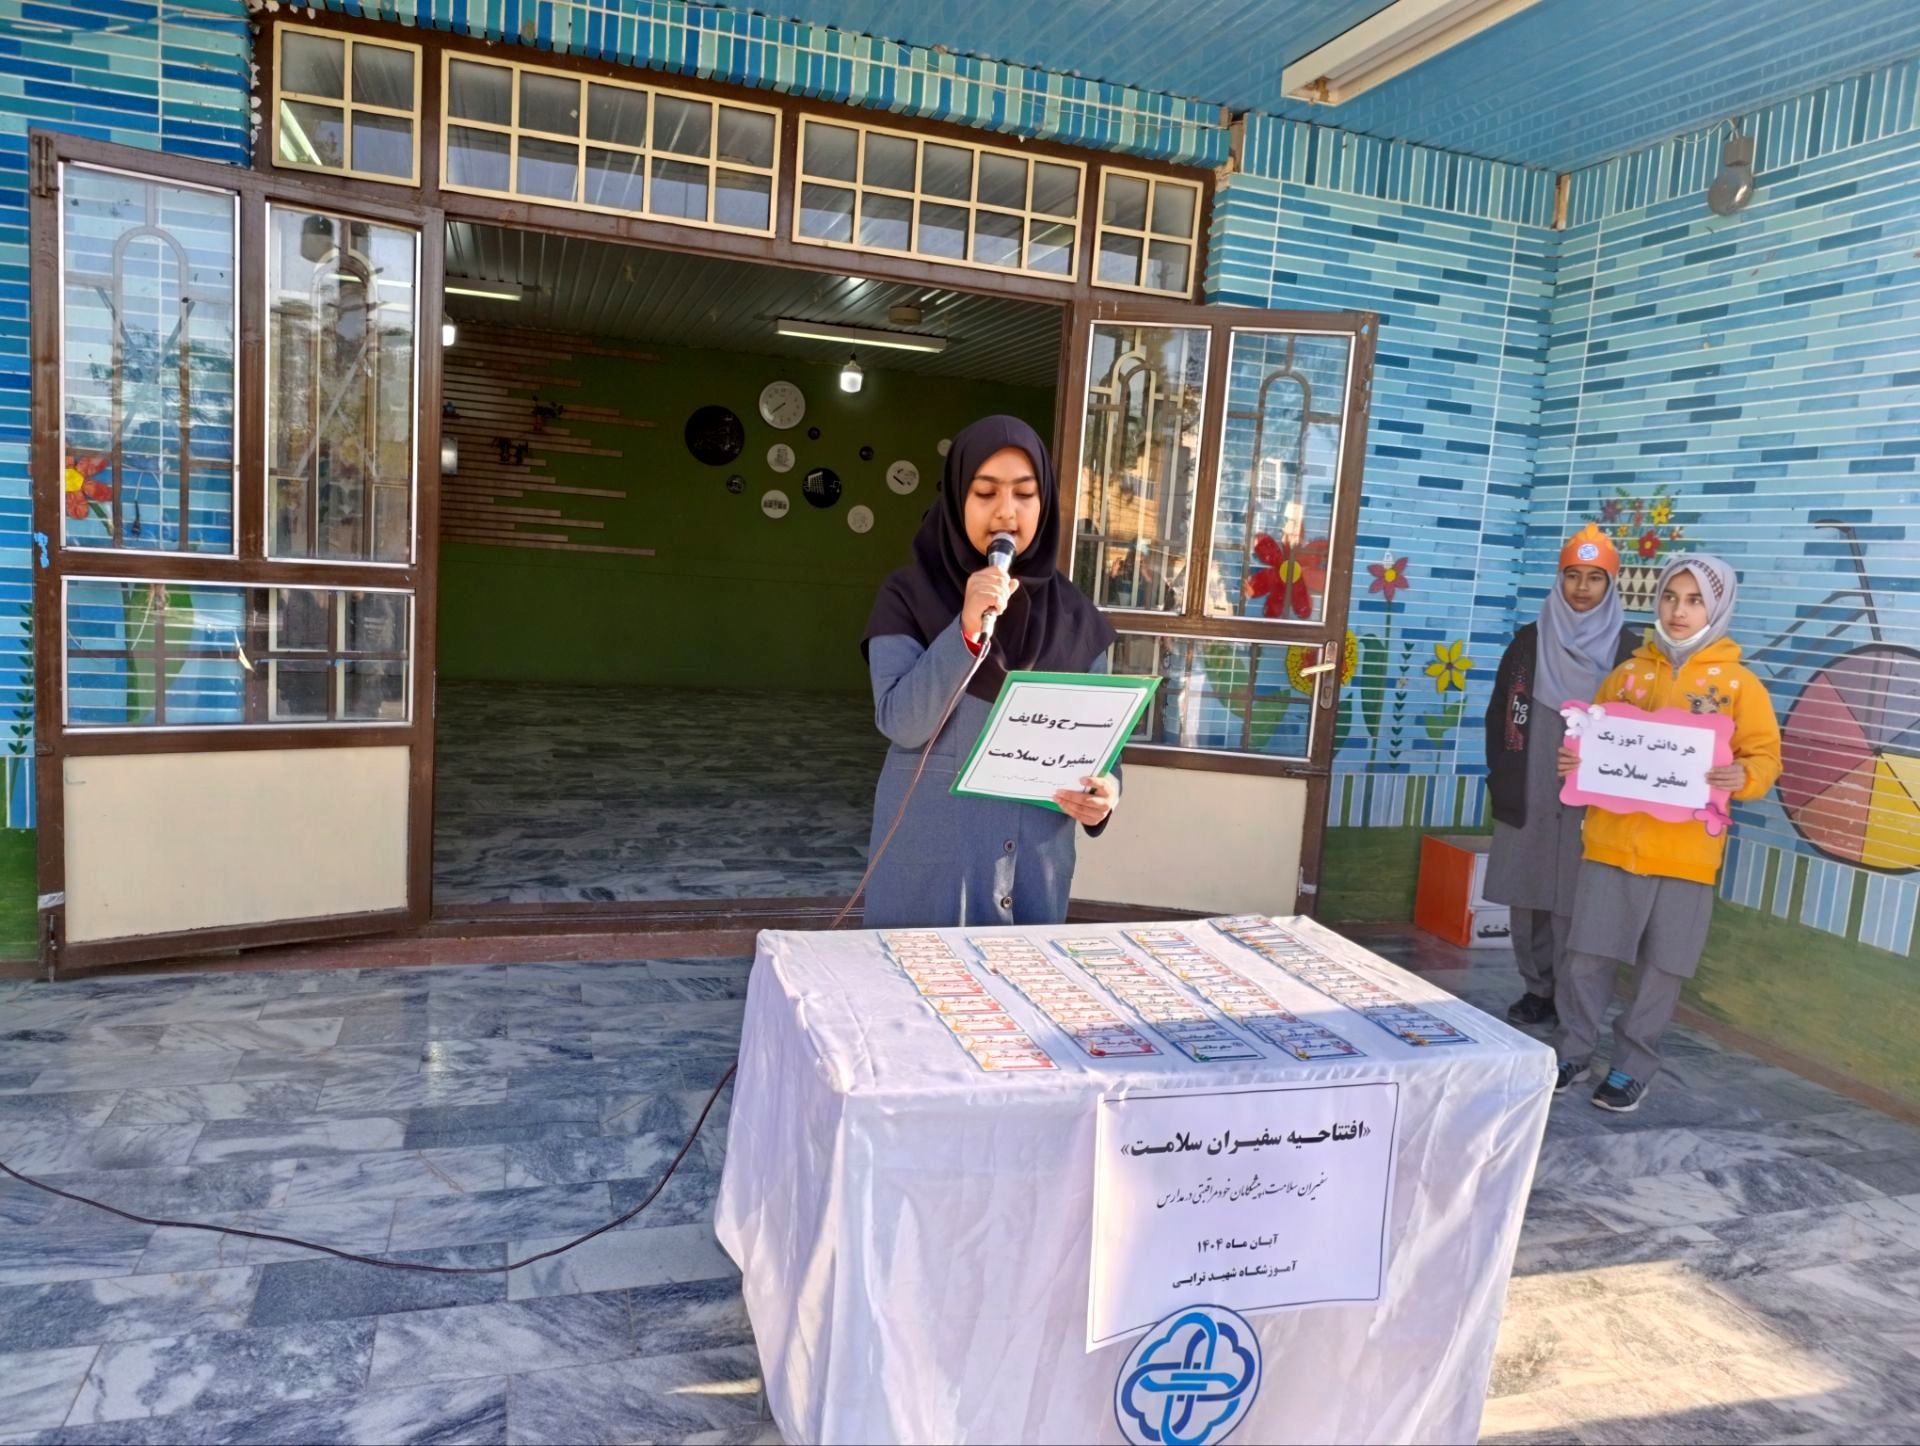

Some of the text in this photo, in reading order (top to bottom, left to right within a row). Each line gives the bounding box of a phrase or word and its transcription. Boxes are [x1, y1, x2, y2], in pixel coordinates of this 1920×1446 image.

[1008, 712, 1113, 730] شرح وظایف
[1597, 730, 1696, 756] هر دانش آموز یک
[987, 748, 1096, 769] سفیران سلامت
[1598, 763, 1689, 789] سفیر سلامت
[1206, 1128, 1282, 1156] سفیران
[1297, 1171, 1329, 1201] سفیران
[1225, 1238, 1248, 1249] ماه
[1249, 1233, 1279, 1250] آبان
[1207, 1266, 1237, 1283] شهید
[1238, 1259, 1298, 1278] آموزشگاه
